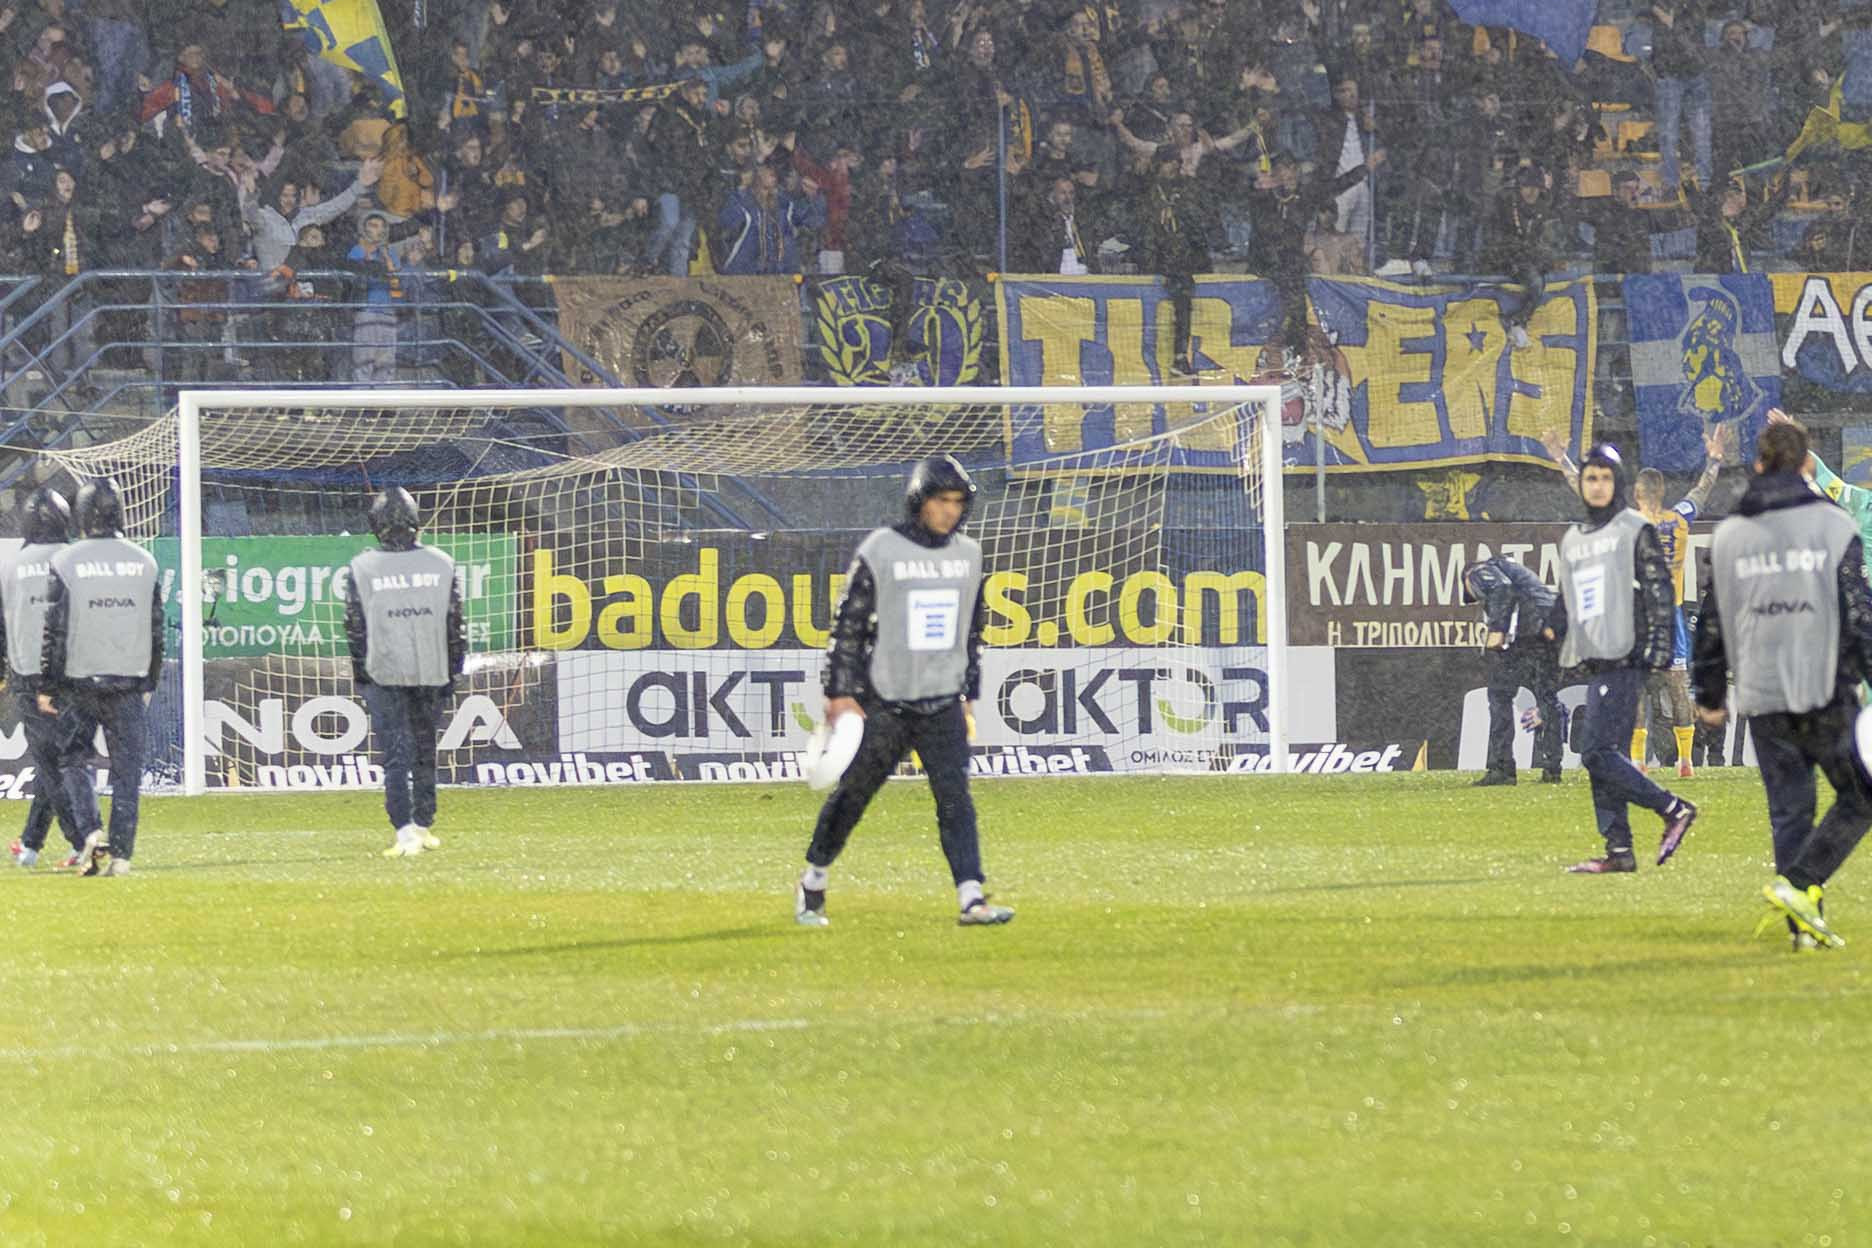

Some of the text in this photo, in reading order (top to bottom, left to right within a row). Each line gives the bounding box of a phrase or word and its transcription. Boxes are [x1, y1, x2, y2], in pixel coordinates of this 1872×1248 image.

[820, 276, 968, 315] TIGRS
[76, 562, 144, 577] BALL BOY
[894, 561, 939, 580] BALL
[1735, 550, 1829, 579] BALL BOY
[372, 573, 440, 591] BALL BOY
[89, 598, 136, 609] NOVA
[388, 608, 433, 618] NOVA
[1752, 601, 1815, 616] NOVA
[1328, 621, 1342, 646] Η
[202, 696, 523, 755] NOA
[257, 755, 385, 788] novib
[478, 753, 655, 784] novibet
